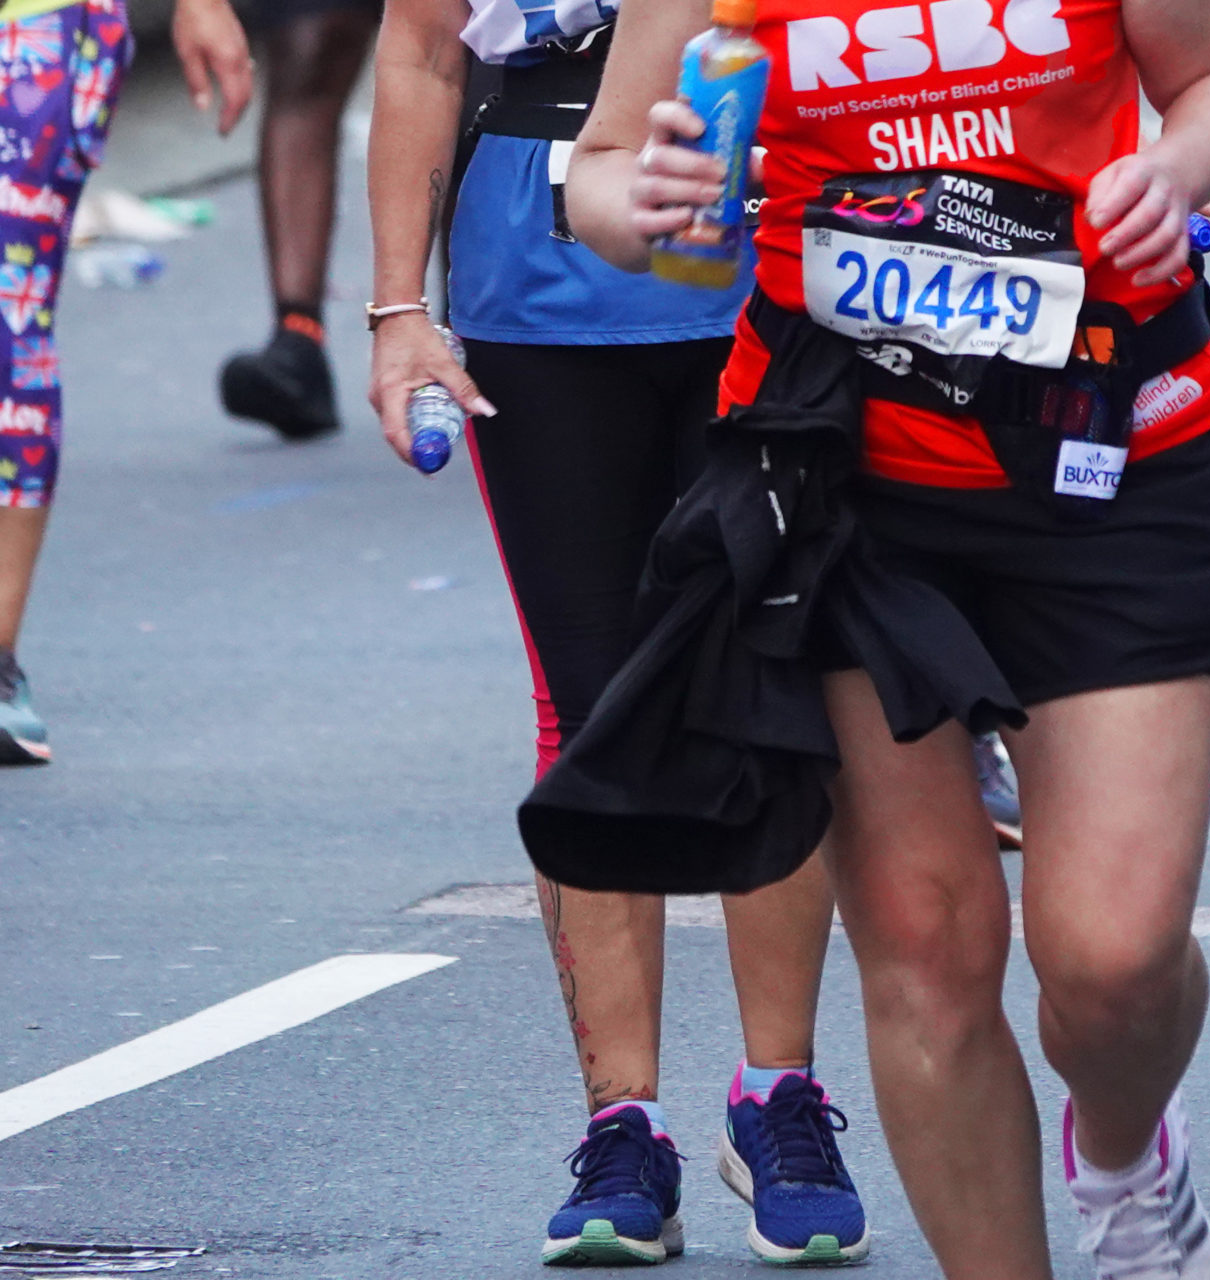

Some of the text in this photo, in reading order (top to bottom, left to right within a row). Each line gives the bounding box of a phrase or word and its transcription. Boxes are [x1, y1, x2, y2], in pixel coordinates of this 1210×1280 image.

[797, 65, 1075, 122] Royal Society for Blind Children
[868, 105, 1015, 171] SHARN
[941, 175, 994, 206] TATA
[934, 214, 1012, 251] SERVICES
[937, 194, 1057, 242] CONSULTANCY
[835, 250, 1042, 336] 20449
